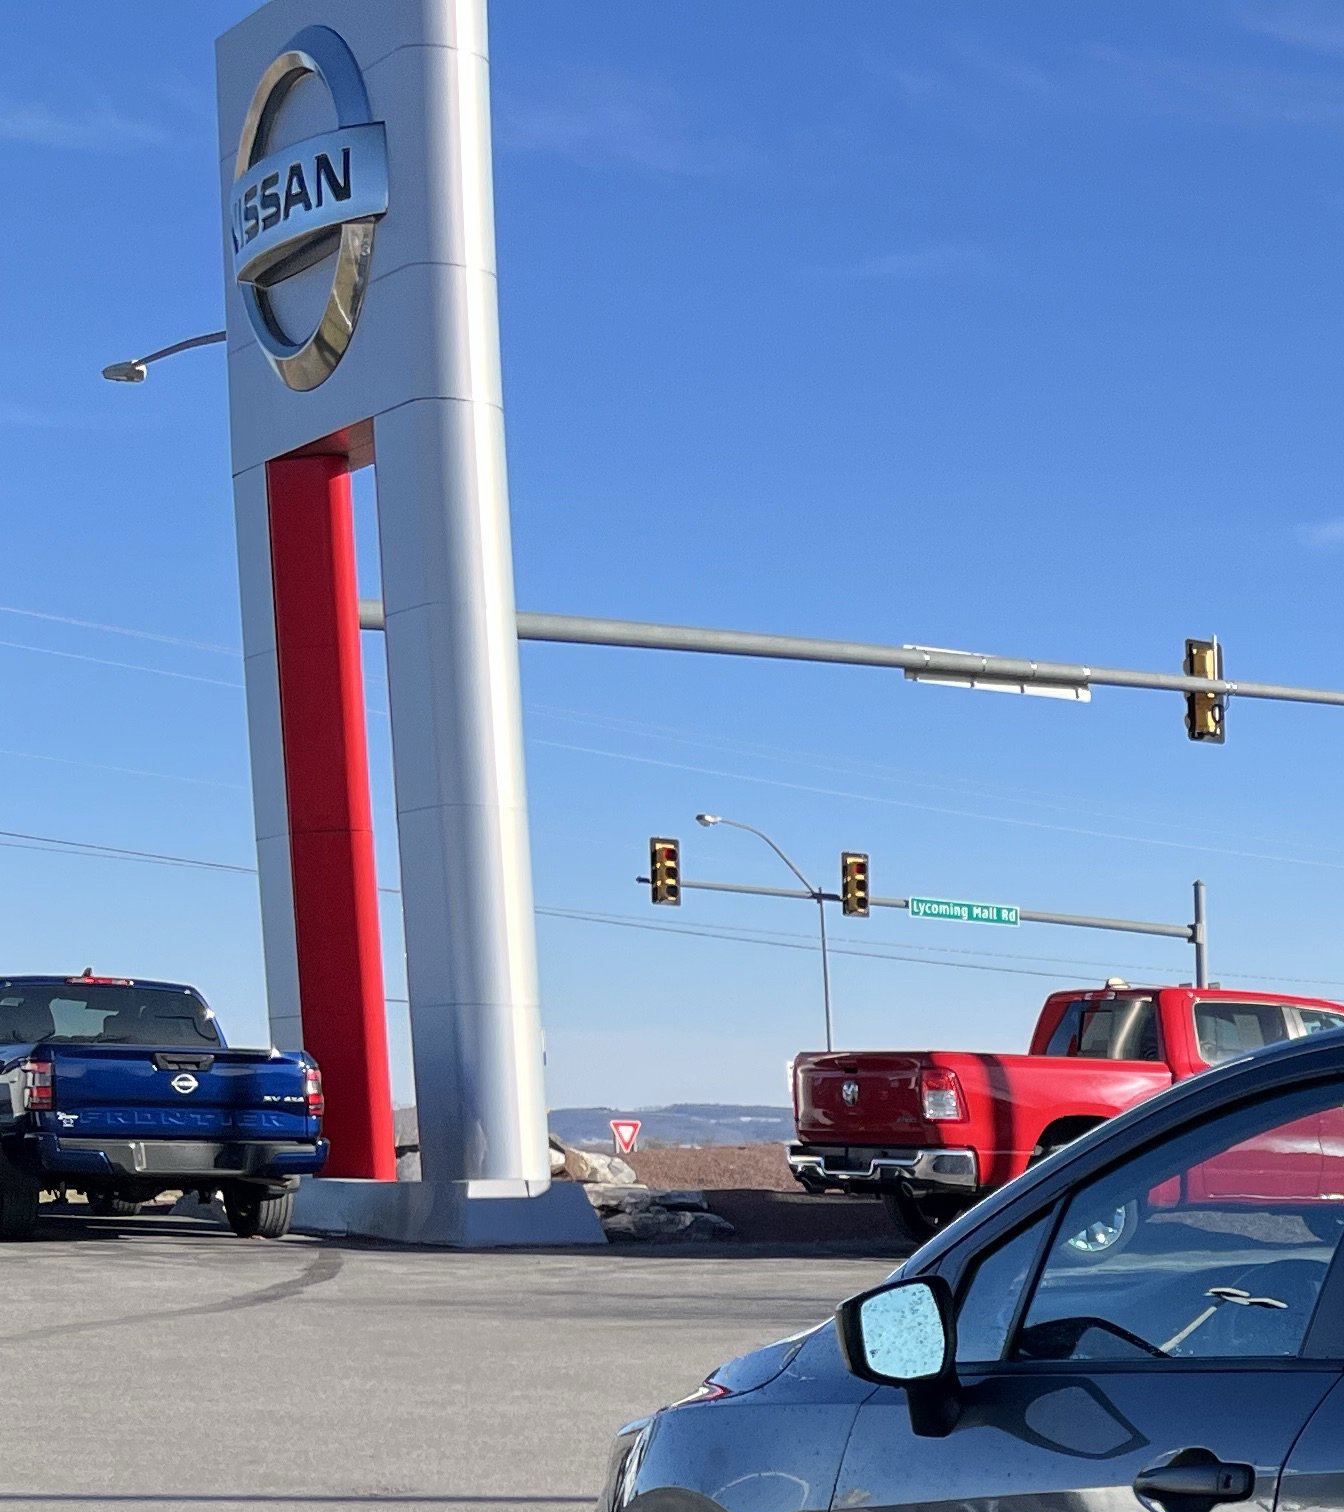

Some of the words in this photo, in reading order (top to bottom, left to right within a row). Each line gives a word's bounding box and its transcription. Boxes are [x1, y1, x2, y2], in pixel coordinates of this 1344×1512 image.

[913, 900, 968, 920] Lycoming
[973, 906, 998, 920] Mall
[1002, 909, 1016, 921] Rd
